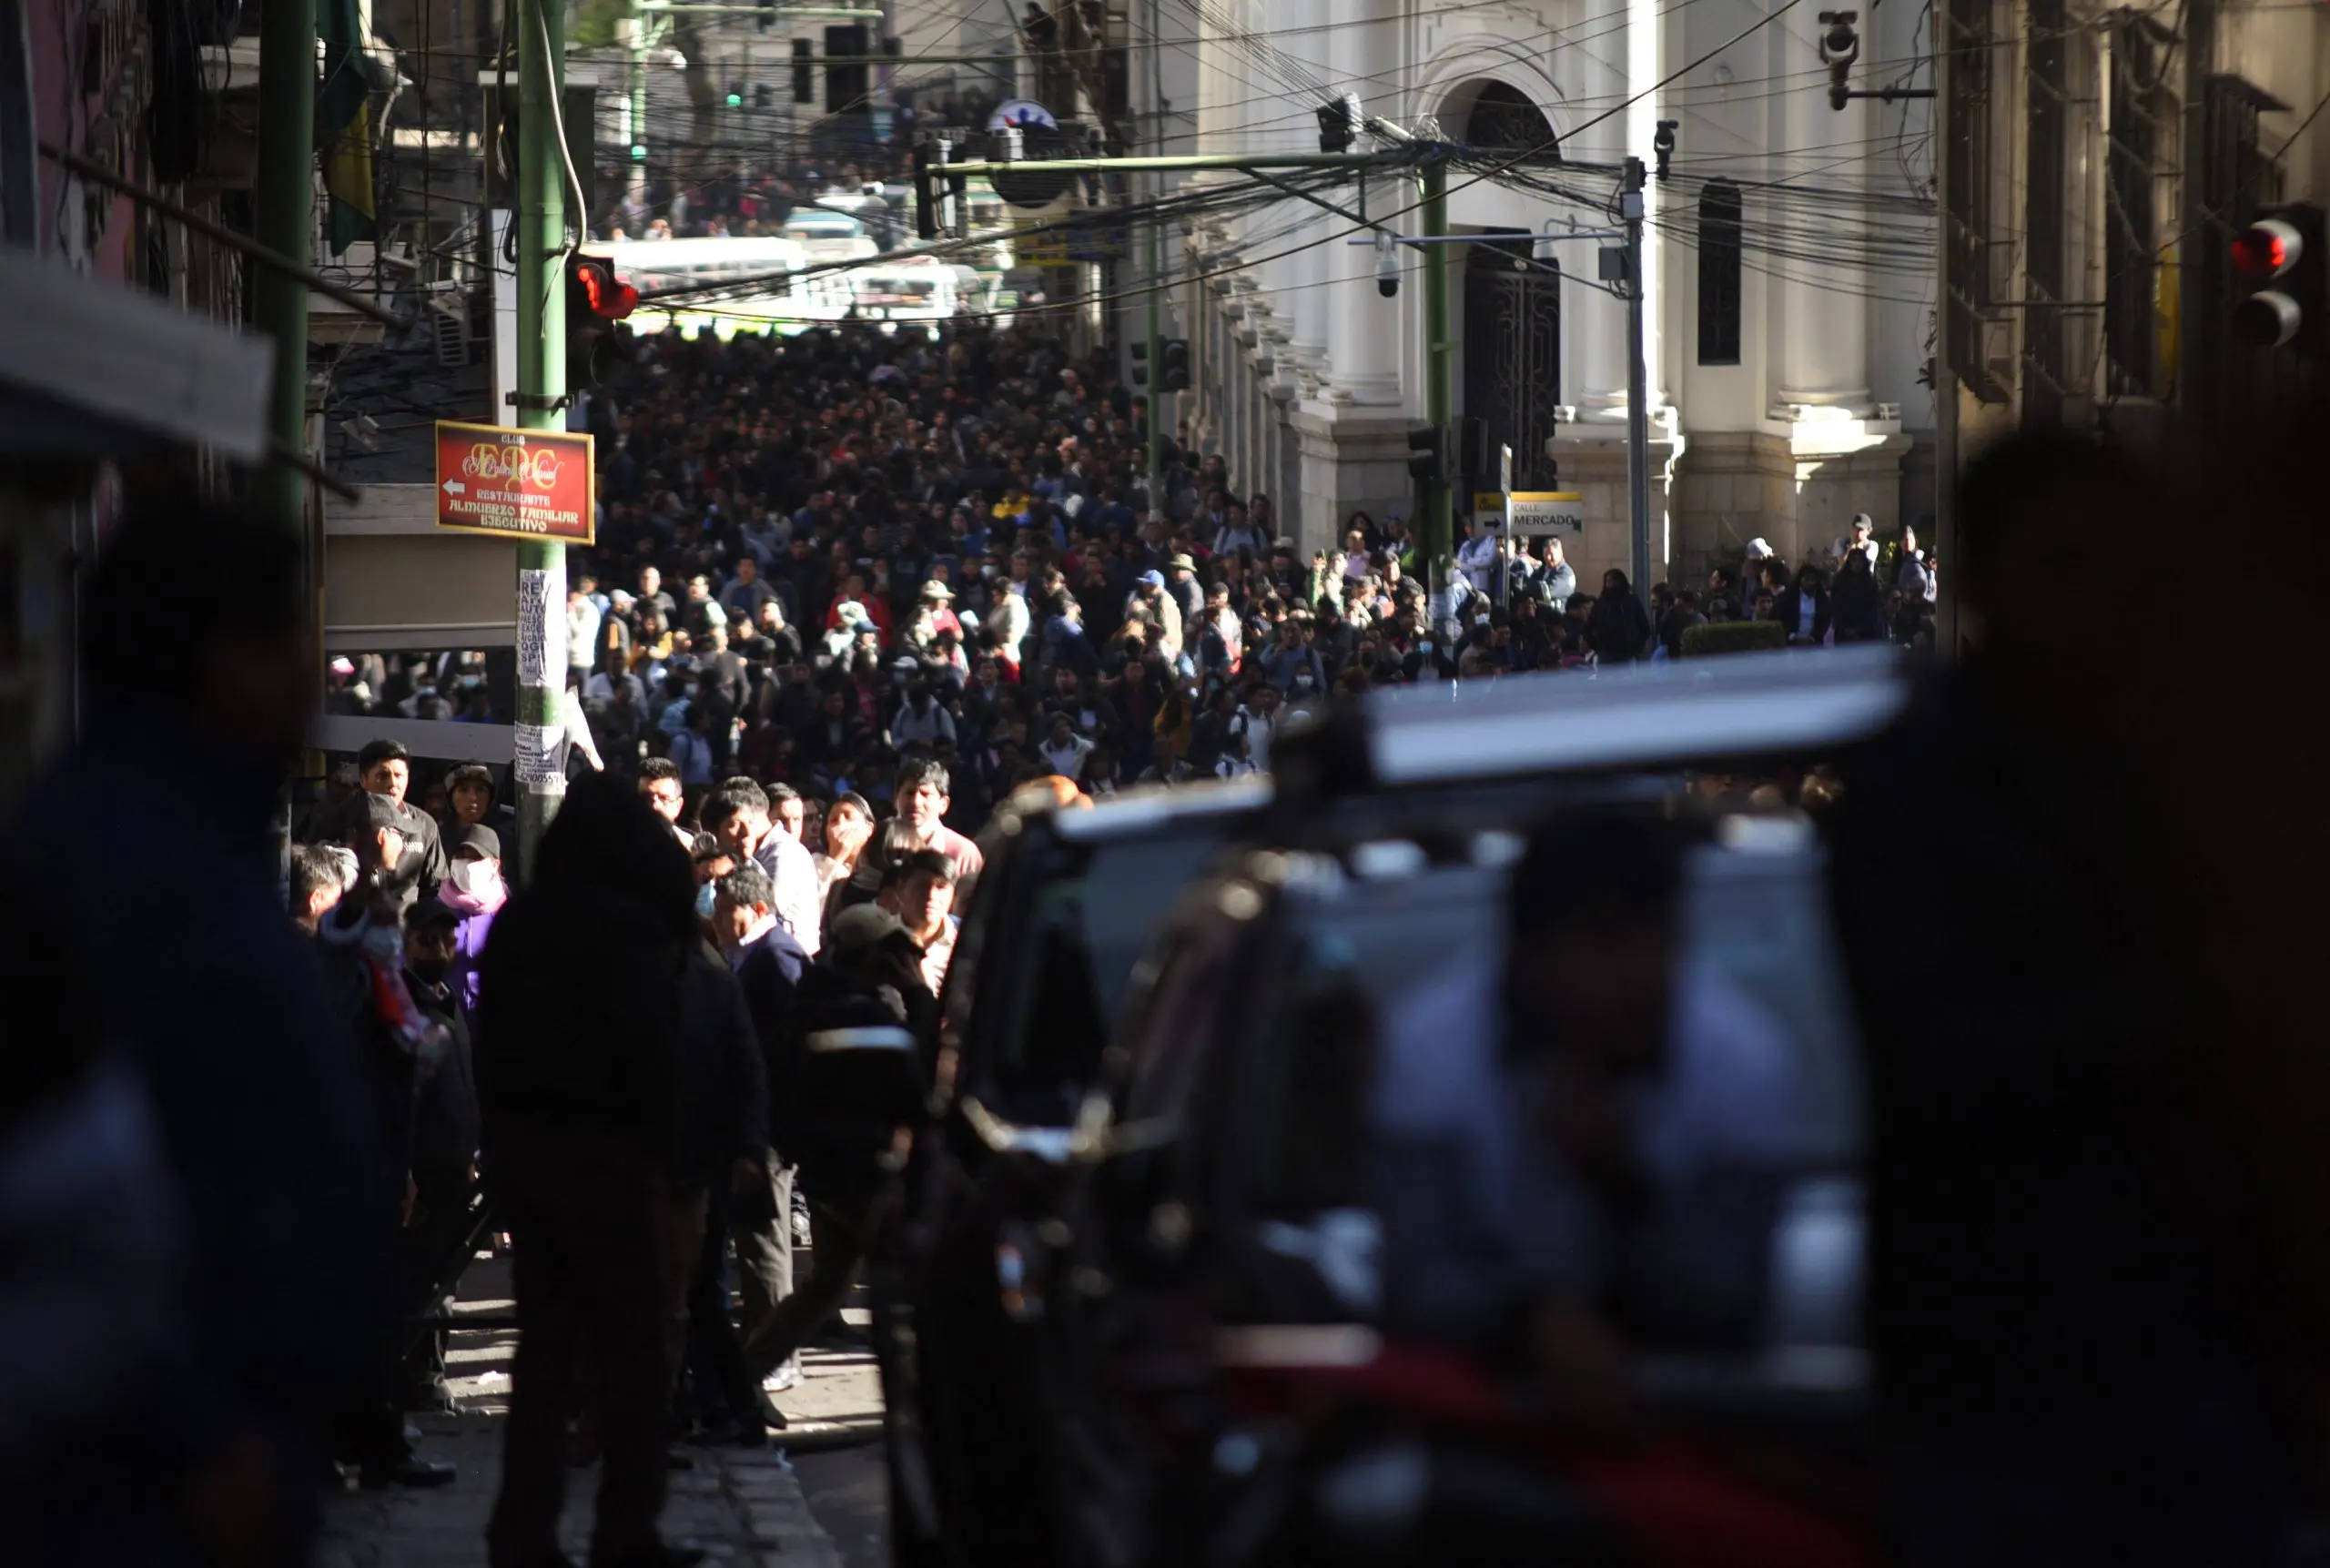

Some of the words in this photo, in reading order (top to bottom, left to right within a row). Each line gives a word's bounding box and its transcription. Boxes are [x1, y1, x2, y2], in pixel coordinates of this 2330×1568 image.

[501, 434, 526, 446] CLUB
[477, 489, 551, 506] RESTAURANTE
[449, 500, 516, 517] ALMUERZO
[520, 507, 580, 525] FAMILIAR
[1514, 503, 1541, 512] CALLE
[481, 514, 548, 532] EJECUTIVO
[1514, 515, 1575, 527] MERCADO
